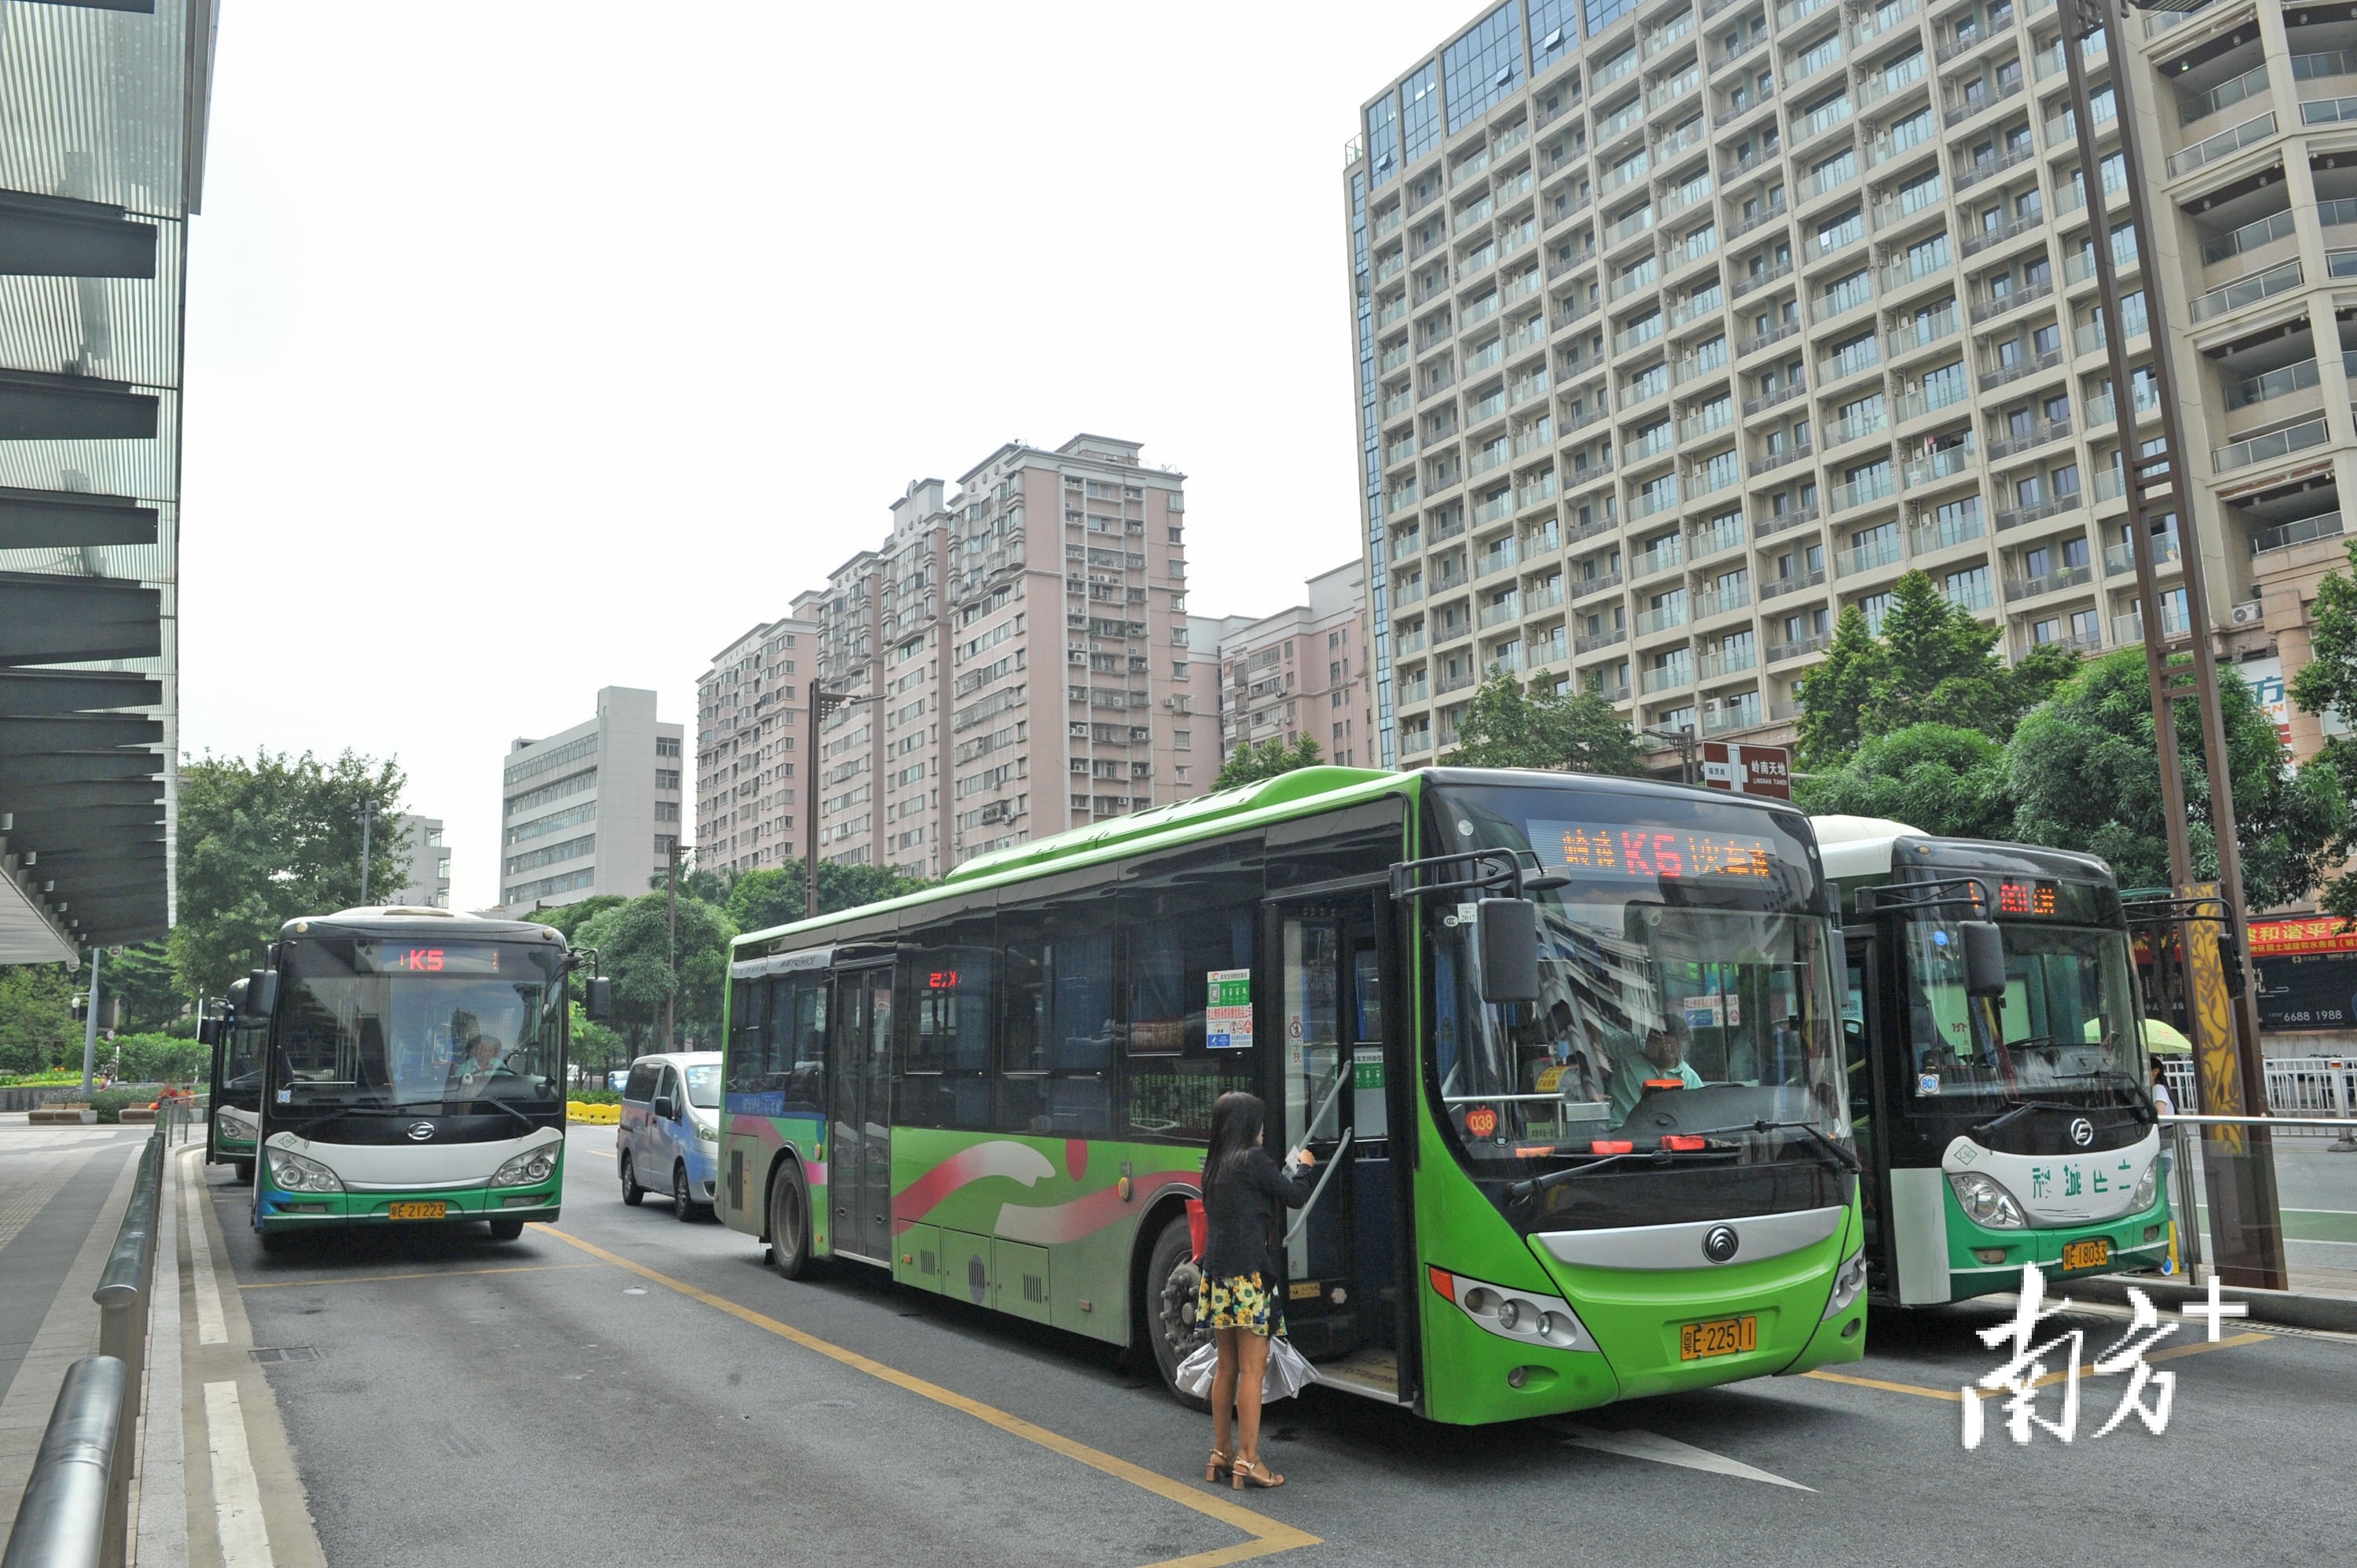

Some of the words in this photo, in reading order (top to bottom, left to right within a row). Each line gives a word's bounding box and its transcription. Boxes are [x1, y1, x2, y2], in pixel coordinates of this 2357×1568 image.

[1751, 760, 1787, 776] 岭南天地
[1622, 831, 1682, 877] K6
[409, 949, 445, 971] K5
[2284, 1011, 2311, 1021] 6688
[2316, 1010, 2342, 1020] 1988
[1922, 1079, 1937, 1090] 801
[1471, 1115, 1493, 1131] 038
[1959, 1150, 1973, 1160] LNG
